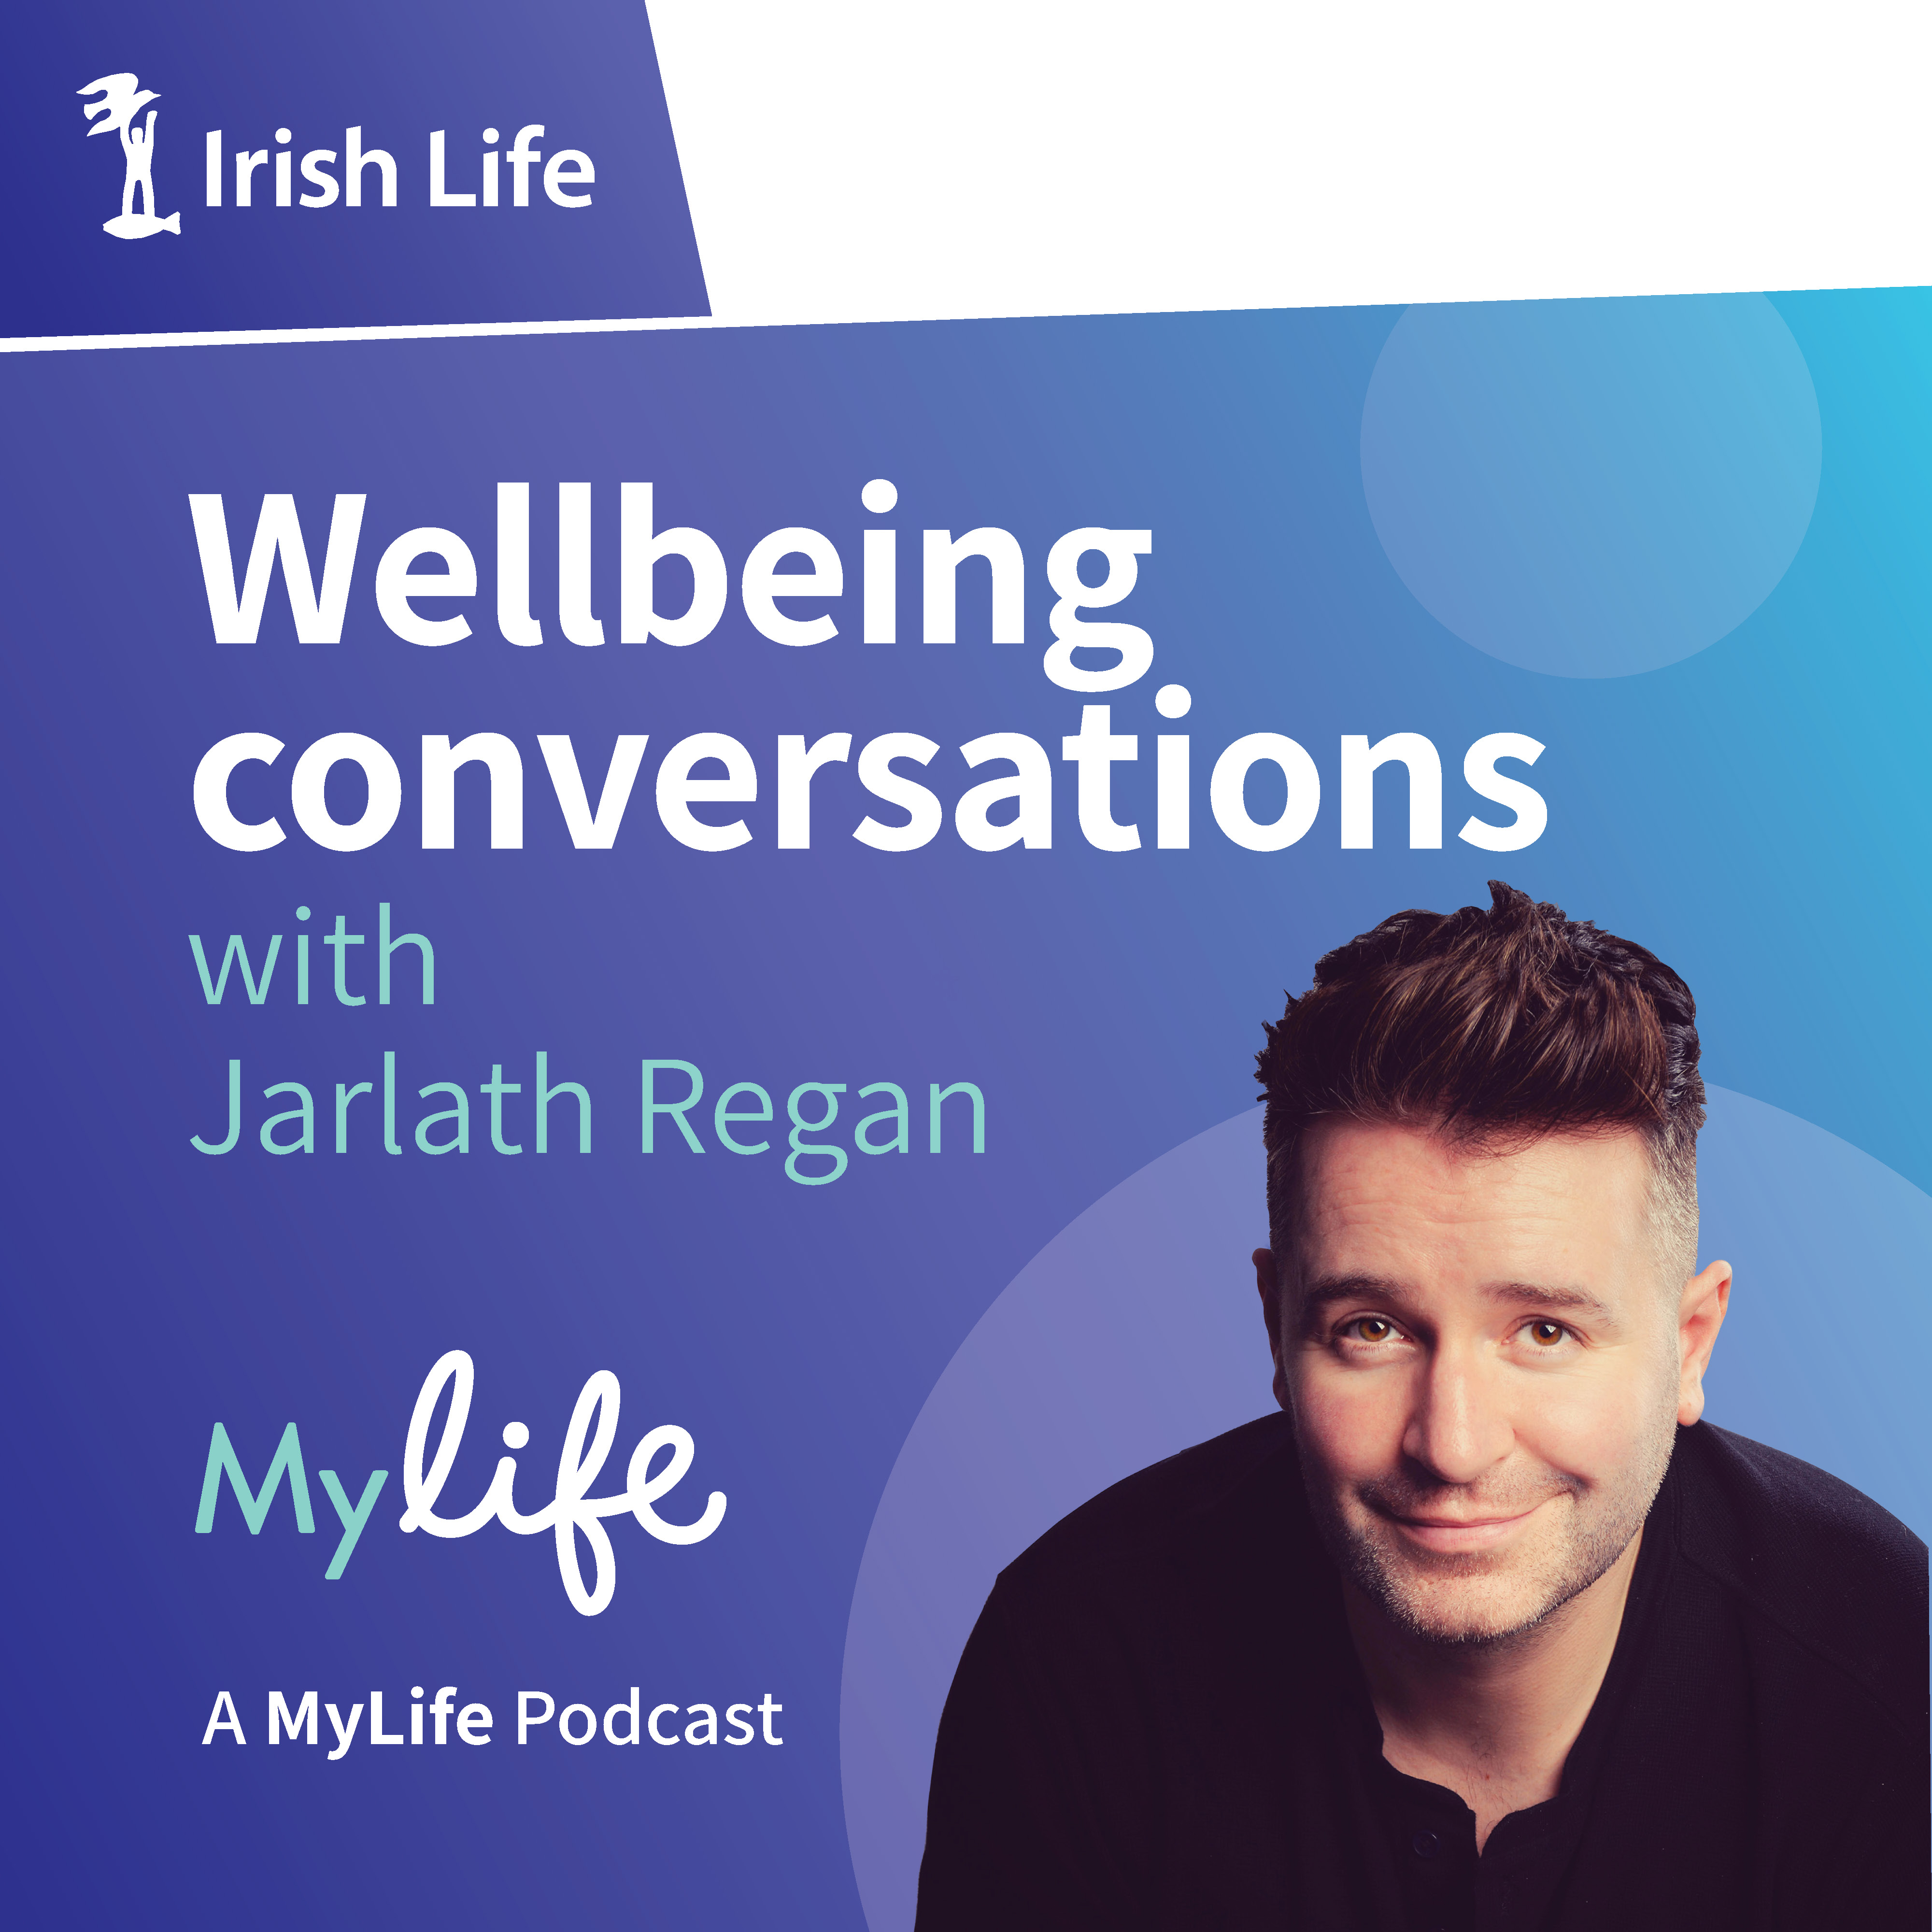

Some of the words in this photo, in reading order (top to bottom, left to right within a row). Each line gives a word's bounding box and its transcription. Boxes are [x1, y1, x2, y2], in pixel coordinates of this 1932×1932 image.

[207, 127, 397, 208] Irish
[430, 125, 595, 208] Life
[188, 479, 1153, 692] Wellbeing
[194, 684, 1547, 852] conversations
[188, 903, 435, 1006] with
[190, 1051, 591, 1155] Jarlath
[642, 1059, 985, 1186] Regan
[202, 1691, 246, 1744] A
[268, 1686, 493, 1760] MyLife
[518, 1687, 783, 1745] Podcast
